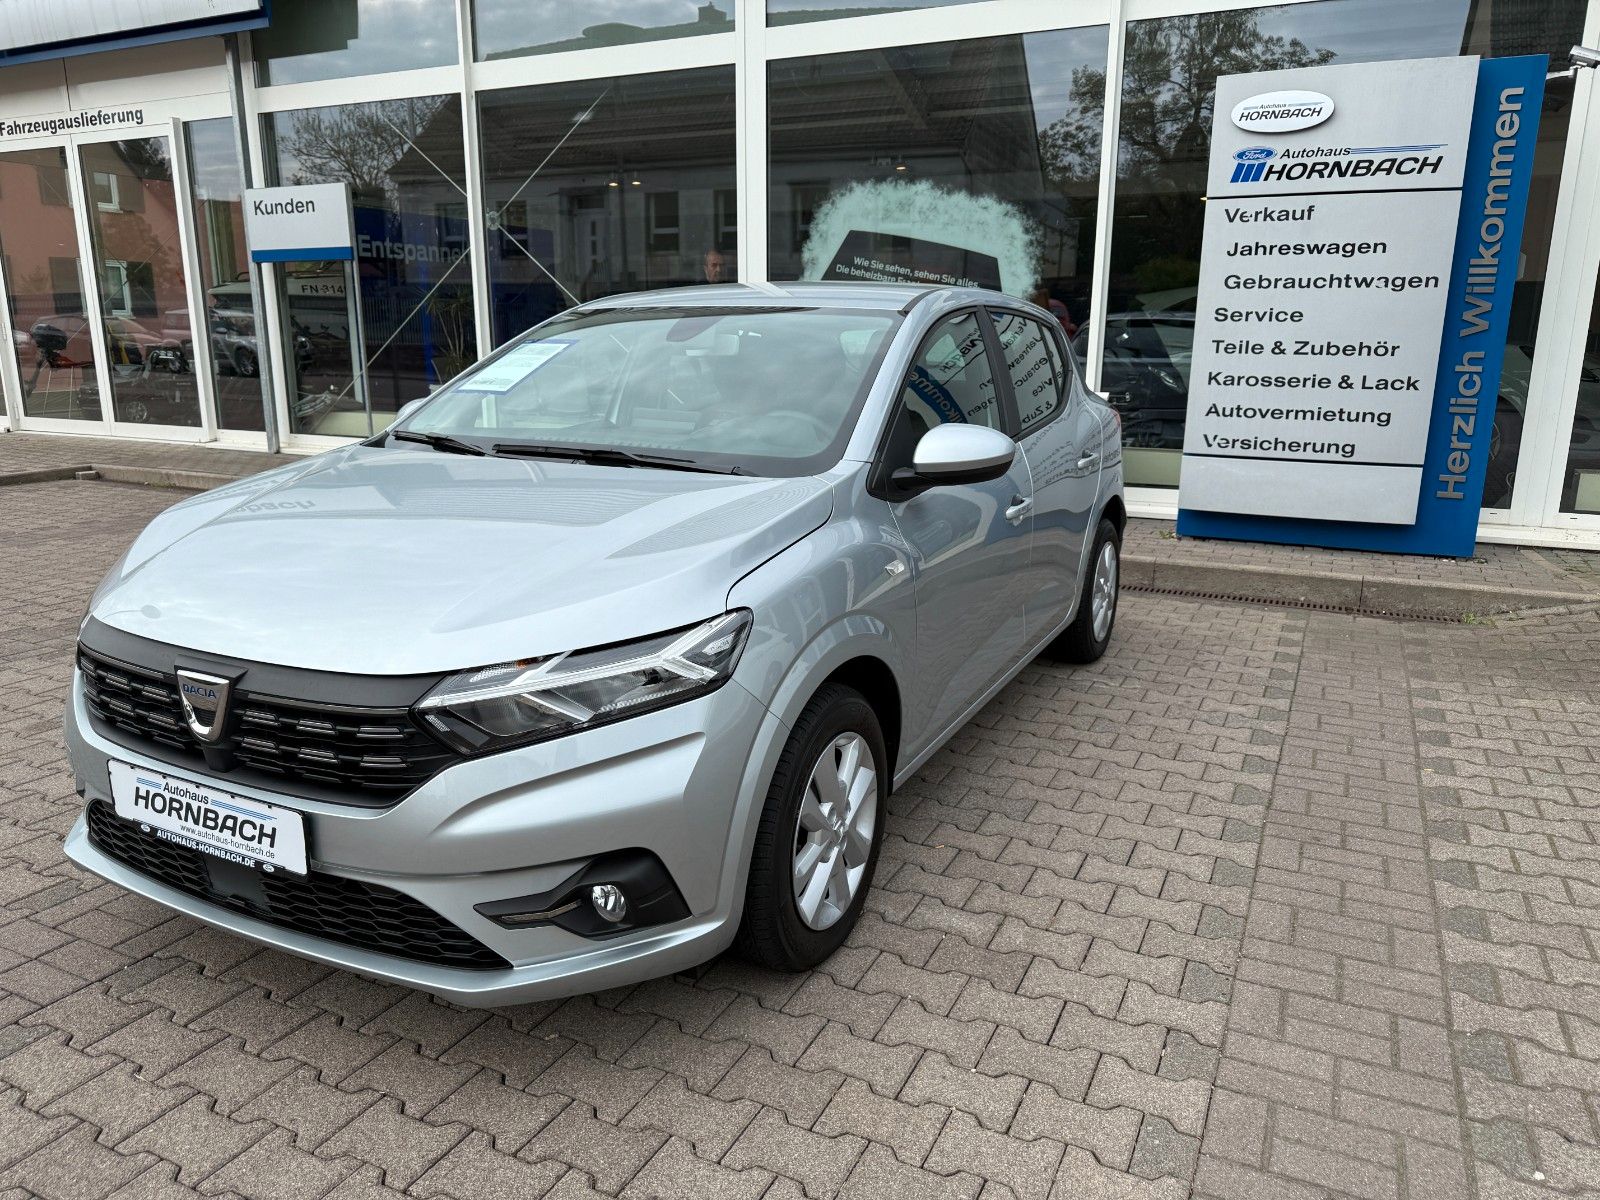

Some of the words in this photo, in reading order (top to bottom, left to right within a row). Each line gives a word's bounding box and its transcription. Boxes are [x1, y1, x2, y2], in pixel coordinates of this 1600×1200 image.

[0, 109, 143, 136] Fahrzeugauslieferung
[1238, 107, 1323, 122] HORNBACH
[1280, 147, 1351, 160] Autohaus
[1263, 155, 1444, 182] HORNBACH
[253, 198, 315, 217] Kunden
[1224, 205, 1315, 223] Verkauf
[1459, 86, 1525, 338] Willkommen
[1227, 241, 1387, 258] Jahreswagen
[835, 264, 850, 275] Die
[853, 256, 869, 267] Wie
[870, 259, 884, 270] Sie
[884, 263, 913, 277] sehen,
[914, 269, 941, 282] sehen
[941, 274, 956, 285] Sie
[1223, 274, 1440, 292] Gebrauchtwagen
[1214, 307, 1304, 323] Service
[1212, 340, 1264, 355] Teile
[1271, 341, 1286, 355] &
[1293, 340, 1400, 358] Zubehör
[1207, 371, 1332, 389] Karosserie
[1337, 375, 1354, 390] &
[1361, 374, 1420, 391] Lack
[1205, 403, 1392, 427] Autovermietung
[1436, 351, 1485, 500] Herzlich
[1203, 433, 1356, 458] Versicherung
[182, 683, 217, 699] DACIA
[163, 782, 209, 804] Autohaus
[134, 786, 277, 848] HORNBACH
[180, 824, 275, 859] www.autohaus-hornbach.de
